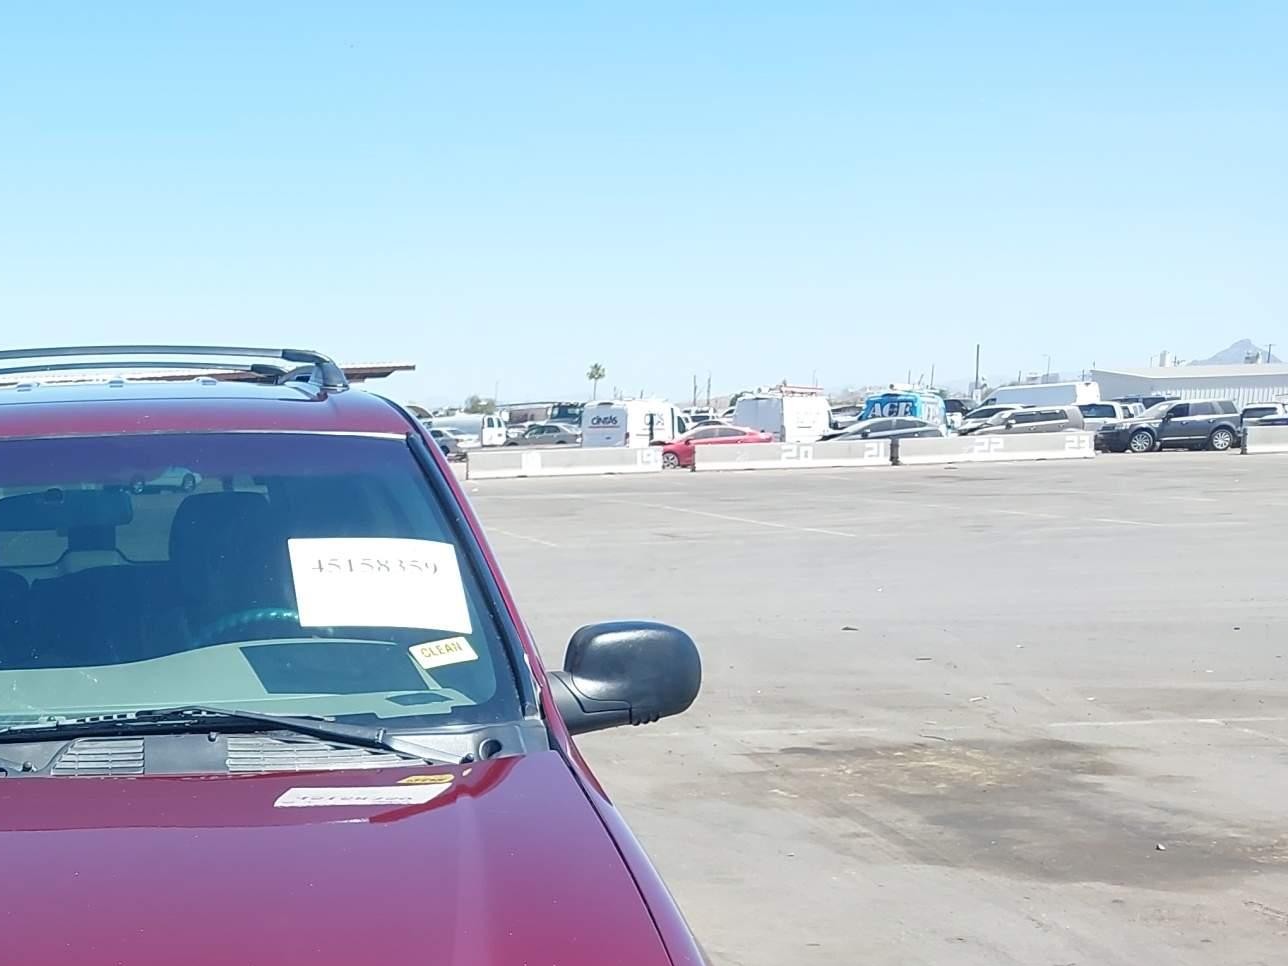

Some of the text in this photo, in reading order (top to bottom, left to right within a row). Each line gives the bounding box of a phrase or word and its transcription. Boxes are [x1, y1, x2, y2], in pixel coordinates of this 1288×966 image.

[868, 402, 912, 417] ACE
[781, 444, 813, 460] 20
[864, 442, 885, 459] 21
[311, 558, 438, 576] 45158359
[420, 641, 464, 658] CLEAN
